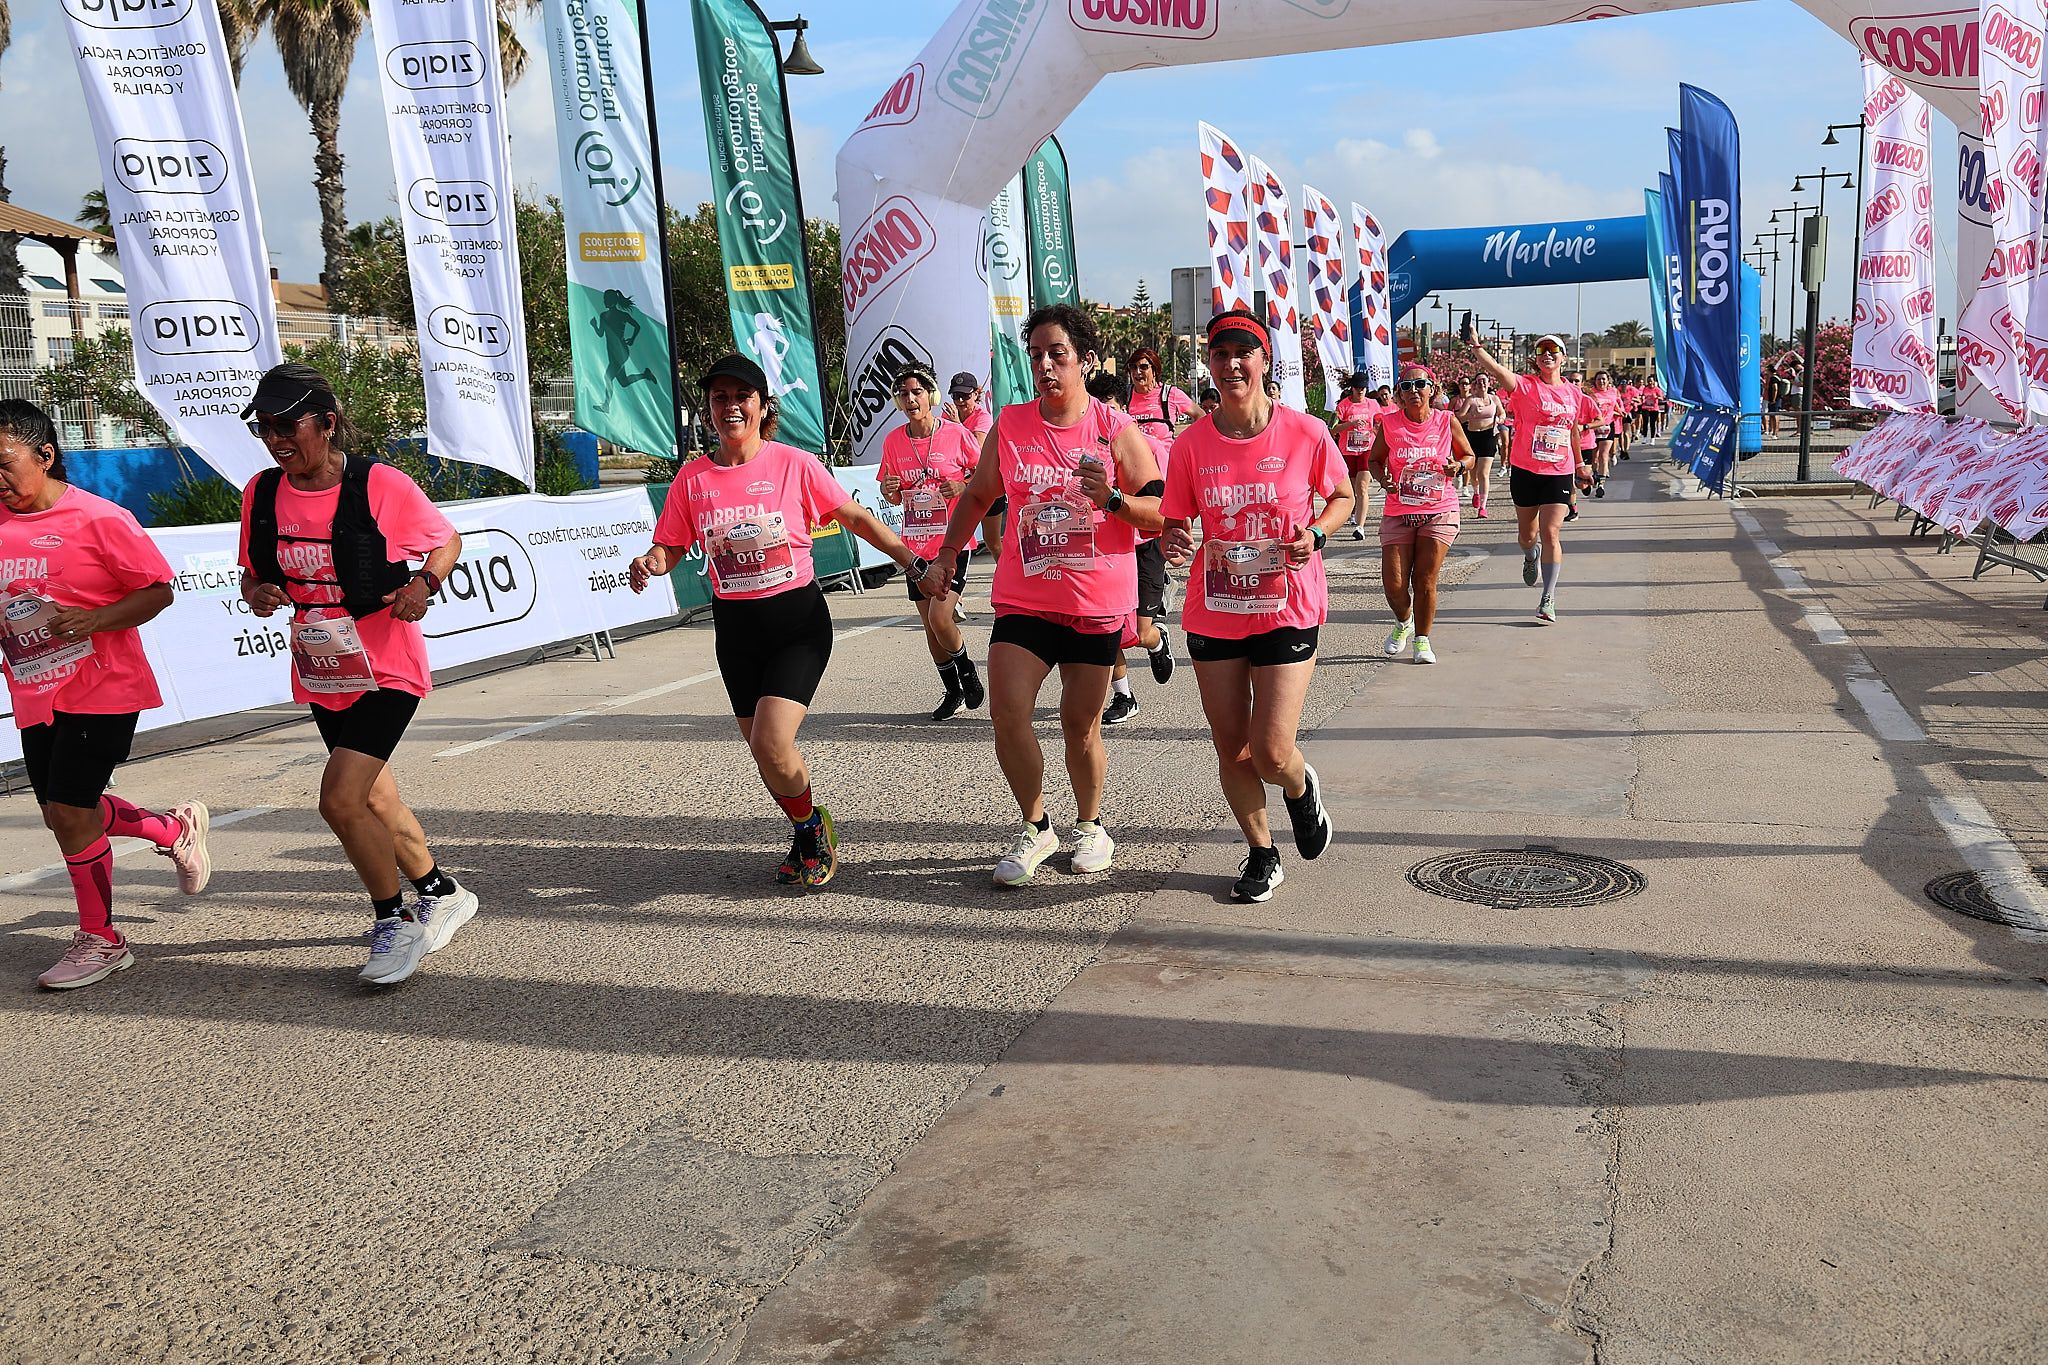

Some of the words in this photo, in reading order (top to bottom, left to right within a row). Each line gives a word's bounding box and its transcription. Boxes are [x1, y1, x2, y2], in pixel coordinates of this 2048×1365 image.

[1482, 226, 1596, 278] Marlene
[843, 208, 923, 312] COSMO
[1396, 447, 1438, 458] CARRERA
[1198, 464, 1229, 474] OYSHO
[691, 489, 720, 501] OYSHO
[1204, 482, 1279, 507] CARRERA
[1412, 484, 1430, 493] 016
[698, 503, 765, 531] CARRERA
[914, 510, 933, 519] 016
[278, 523, 299, 534] SHO
[528, 526, 581, 546] COSMÉTICA
[610, 520, 652, 536] CORPORAL
[730, 529, 760, 539] ASTURIANA
[1039, 533, 1069, 546] 016
[277, 545, 334, 570] CARRE
[580, 548, 587, 560] Y
[588, 545, 621, 560] CAPILAR
[736, 550, 766, 564] 016
[1228, 552, 1258, 560] ASTURIANA
[1042, 569, 1062, 581] 2026
[1230, 574, 1260, 587] 016
[411, 554, 517, 612] iaja
[221, 600, 232, 615] Y
[1214, 600, 1239, 609] OYSHO
[18, 626, 52, 647] 016
[57, 648, 84, 661] Santander
[311, 656, 340, 668] 016
